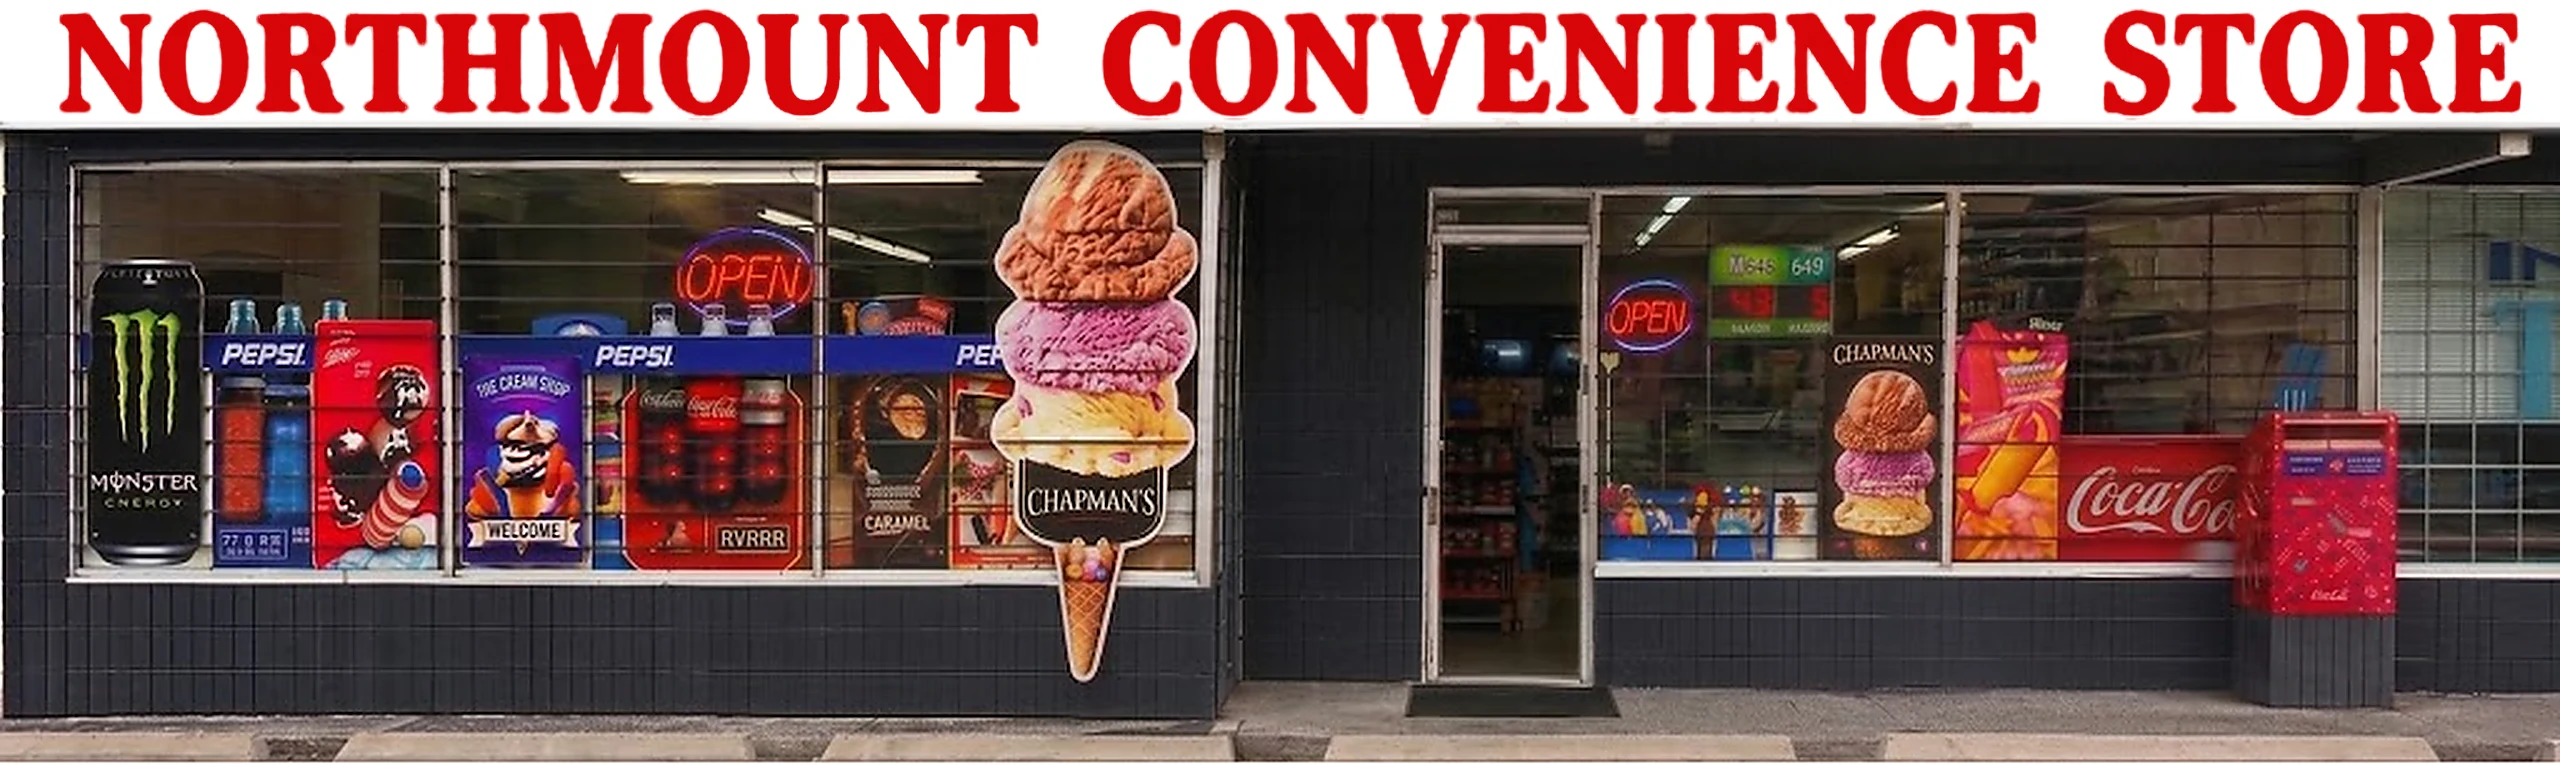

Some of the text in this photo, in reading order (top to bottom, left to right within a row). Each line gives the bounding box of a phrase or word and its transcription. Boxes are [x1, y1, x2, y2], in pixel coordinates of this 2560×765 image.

[59, 9, 2522, 117] NORTHMOUNT CONVENIENCE STORE
[1791, 256, 1824, 276] 649
[685, 254, 803, 301] OPEN
[1608, 299, 1687, 335] OPEN
[956, 344, 1001, 366] PEP
[1833, 344, 1934, 366] CHAPMAN'S
[91, 470, 198, 493] MONSTER
[1027, 487, 1156, 517] CHAPMAN'S
[2067, 465, 2238, 533] Coca-Co
[488, 522, 561, 539] WELCOME
[864, 514, 931, 531] CARAMEL
[721, 529, 786, 547] RVRRR
